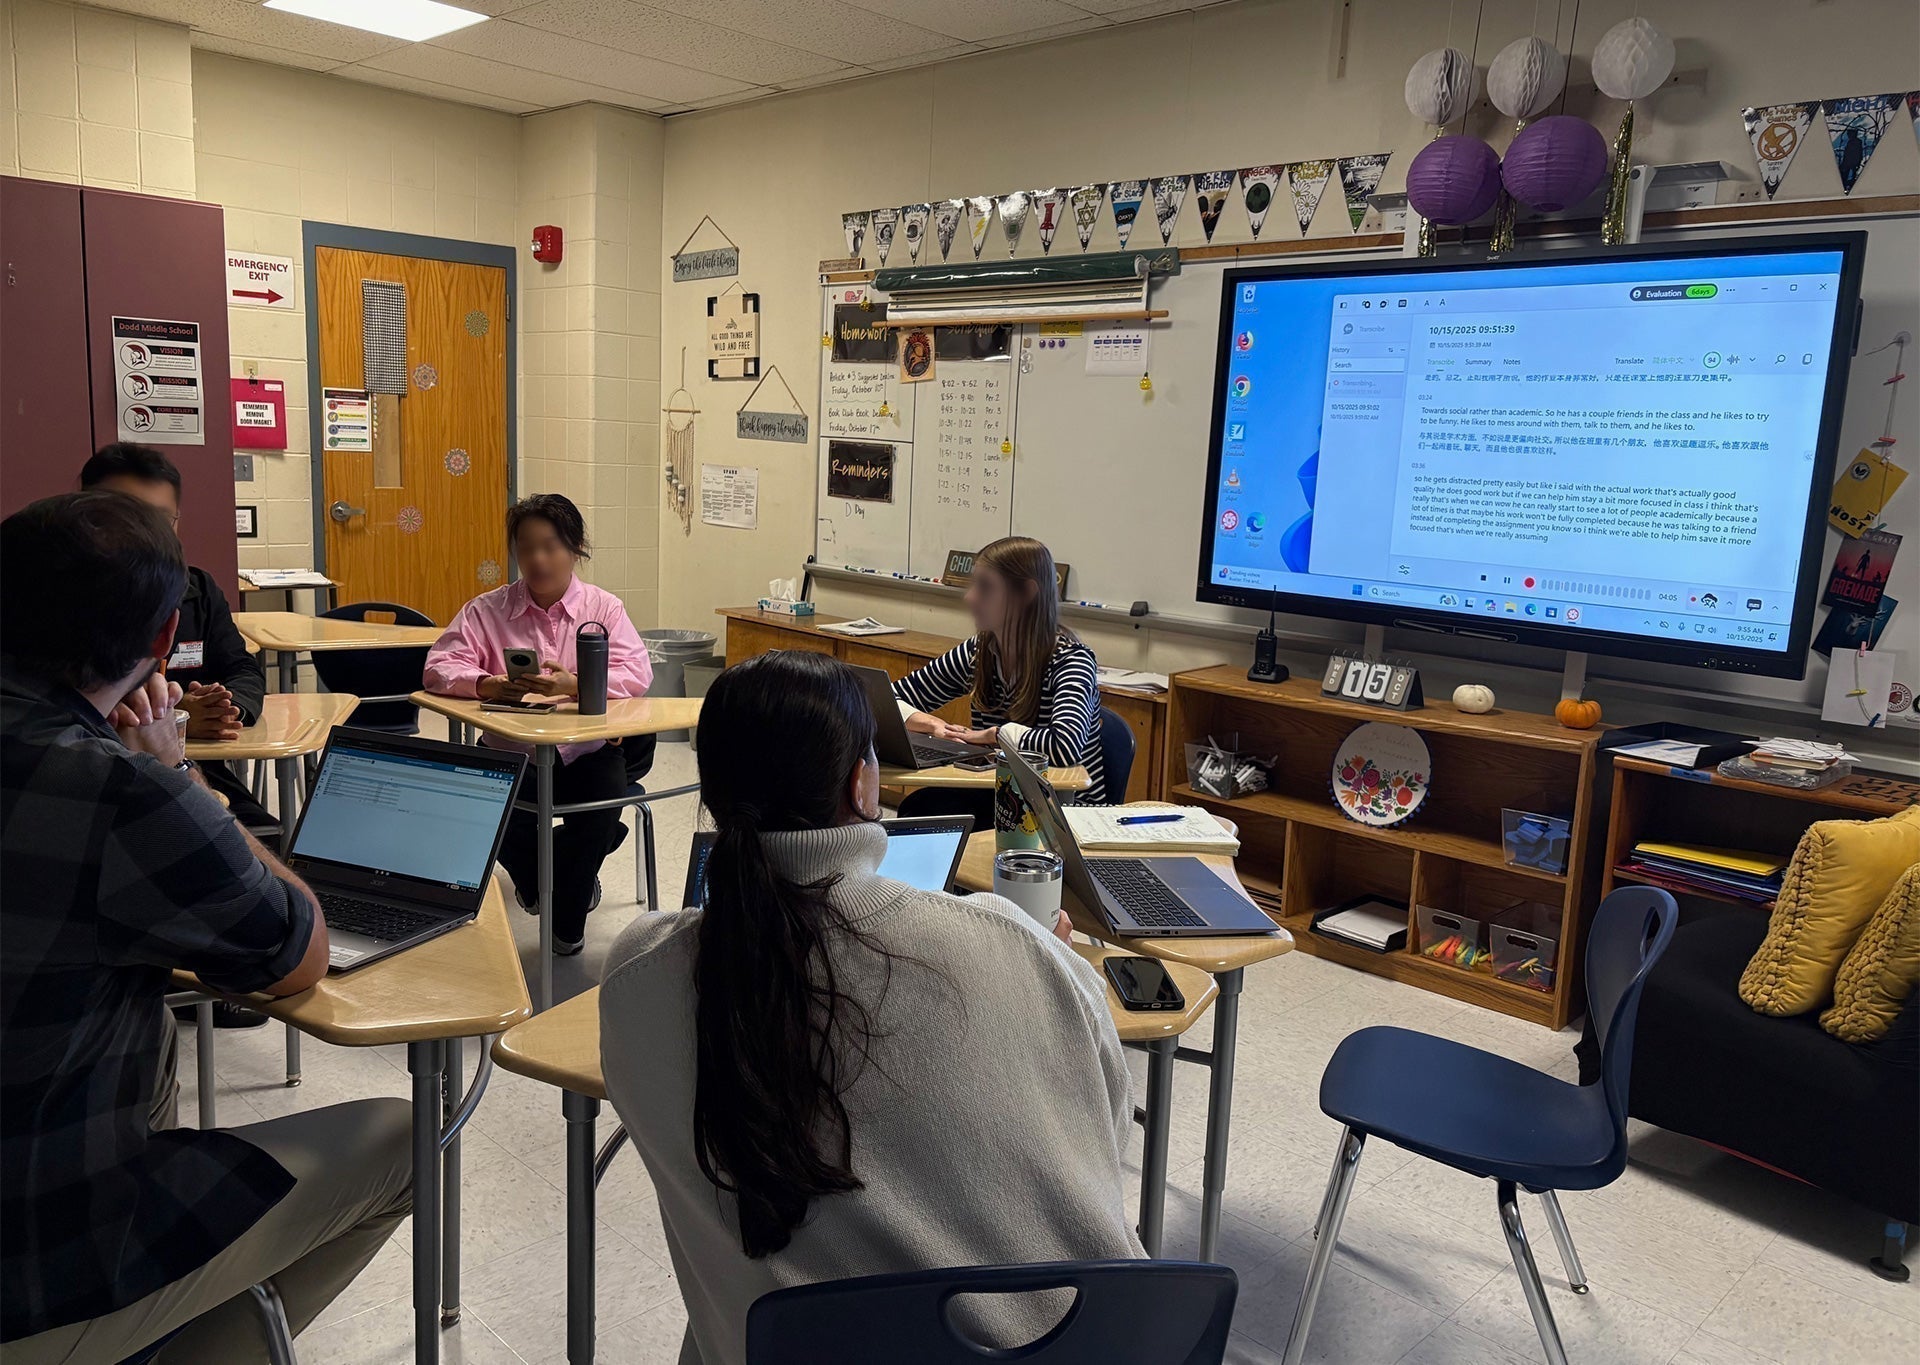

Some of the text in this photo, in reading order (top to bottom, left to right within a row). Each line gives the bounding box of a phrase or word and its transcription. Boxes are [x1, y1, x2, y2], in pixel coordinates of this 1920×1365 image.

[228, 258, 289, 273] EMERGENCY
[248, 271, 270, 282] EXIT
[1646, 289, 1682, 298] Evaluation
[120, 323, 193, 335] Dodd Middle School
[1429, 325, 1515, 335] 10/15/2025 09:51:39
[714, 341, 750, 351] WILD AND FREE
[1465, 358, 1492, 367] Summary
[1422, 406, 1447, 414] Towards
[1508, 408, 1543, 416] academic.
[1588, 409, 1614, 419] couple
[1756, 412, 1769, 422] try
[1438, 417, 1458, 427] funny.
[1516, 419, 1541, 427] around
[1560, 420, 1581, 429] them,
[1610, 421, 1631, 430] them,
[831, 458, 889, 481] Reminders
[1433, 476, 1446, 486] gets
[1448, 476, 1481, 485] distracted
[1482, 478, 1503, 488] pretty
[1504, 479, 1524, 490] easily
[1525, 480, 1538, 488] but
[1539, 481, 1552, 489] like
[1558, 482, 1573, 490] said
[1575, 483, 1591, 491] with
[1593, 484, 1605, 492] the
[1607, 484, 1630, 493] actual
[1632, 486, 1652, 494] work
[1654, 487, 1676, 496] that's
[1678, 488, 1711, 499] actually
[1712, 490, 1736, 500] good
[854, 503, 865, 520] Day
[1872, 534, 1898, 545] GRATZ
[950, 555, 974, 574] CHO
[1829, 577, 1881, 604] GRENADE
[1658, 593, 1678, 602] 04:05
[1726, 632, 1763, 643] 10/15/2025
[1328, 663, 1341, 685] WED
[1391, 674, 1405, 700] OCT
